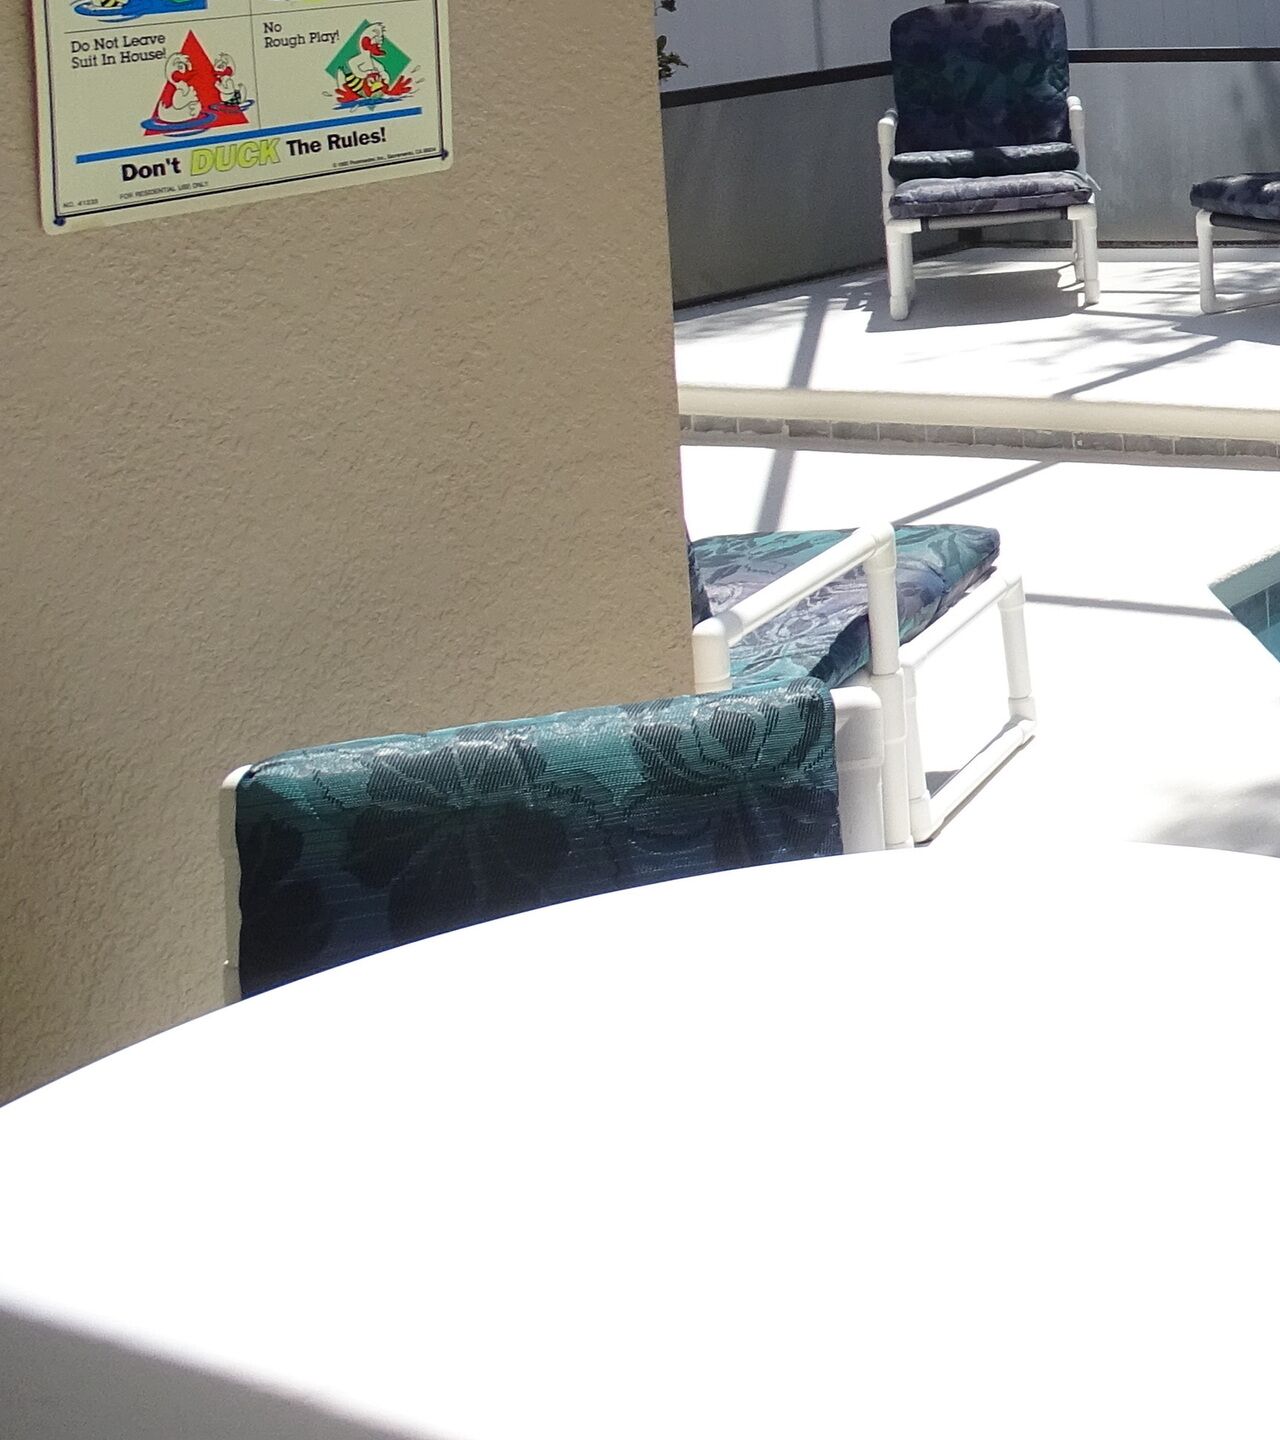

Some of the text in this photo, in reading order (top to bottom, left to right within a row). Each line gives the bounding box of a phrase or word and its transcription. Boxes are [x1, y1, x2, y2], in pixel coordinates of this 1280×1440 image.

[263, 21, 283, 34] No
[70, 34, 166, 53] Do Not Leave
[264, 29, 340, 49] Rough Play!
[71, 47, 167, 69] Suit In House!
[121, 126, 387, 182] Don't DUCK The Rules!
